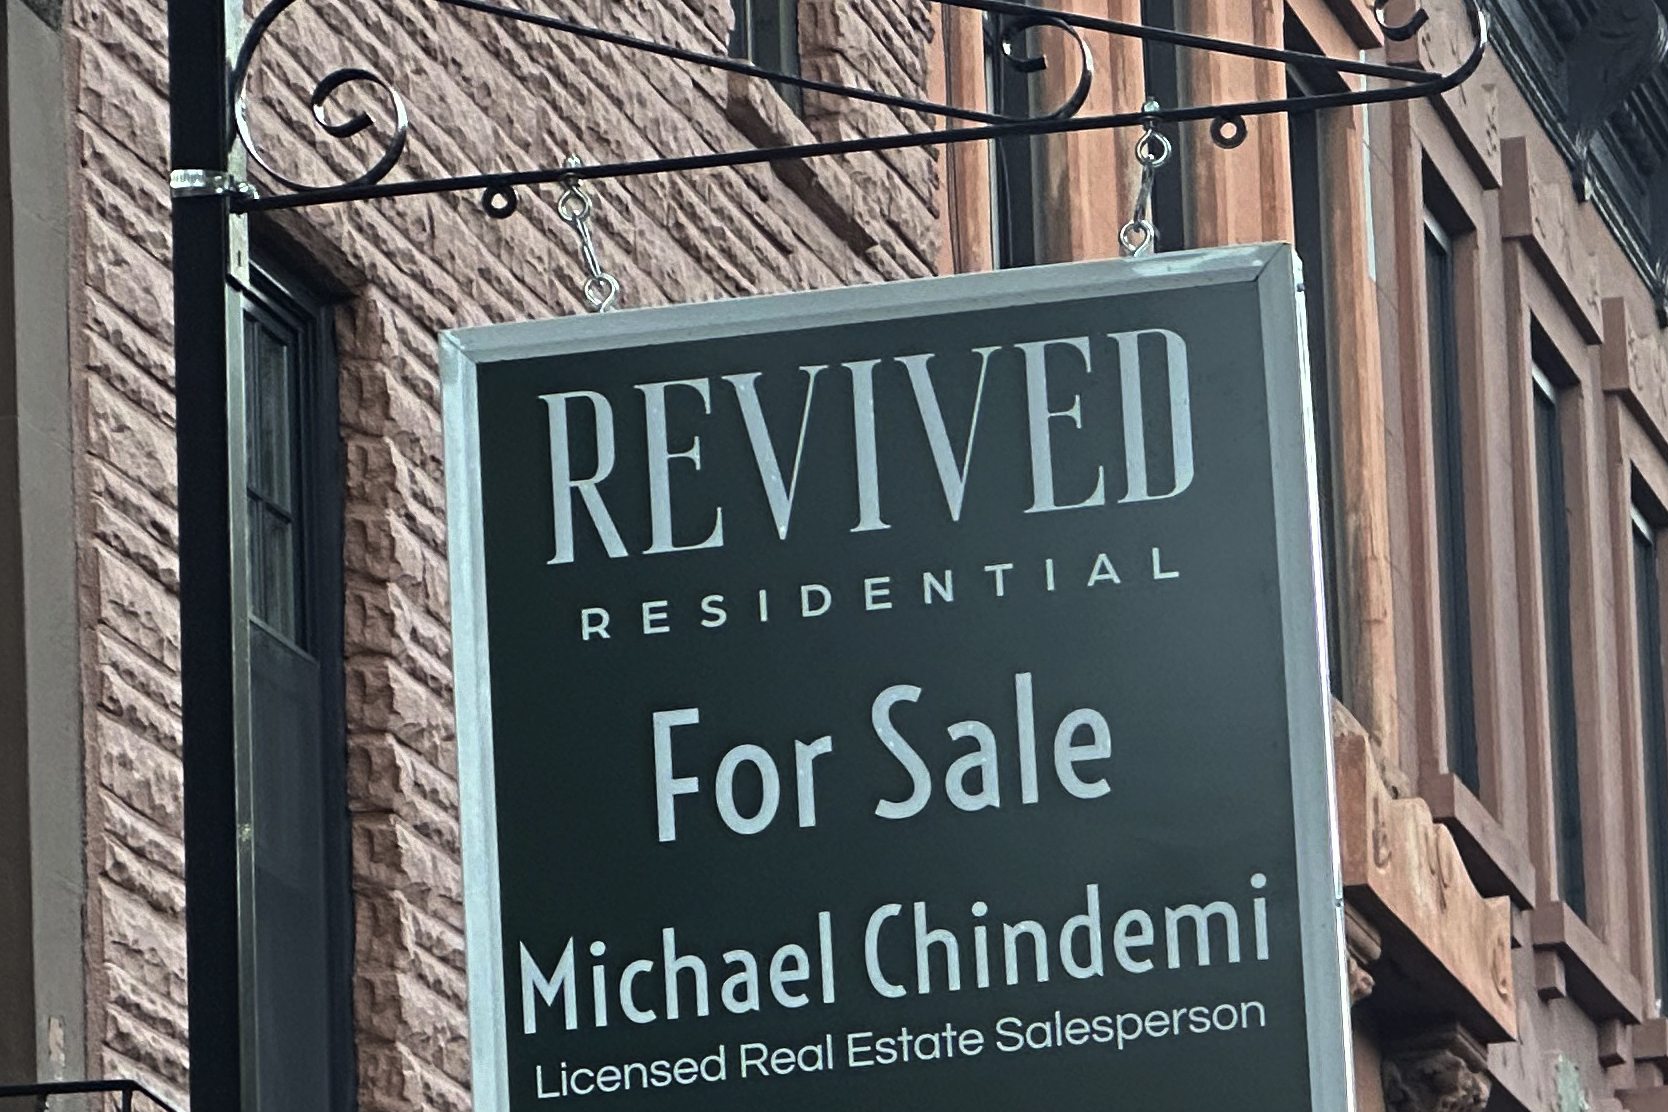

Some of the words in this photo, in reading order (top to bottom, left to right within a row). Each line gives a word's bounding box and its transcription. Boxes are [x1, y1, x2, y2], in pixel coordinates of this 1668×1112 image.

[538, 328, 1195, 564] REVIVED
[581, 548, 1180, 640] RESIDENTIAL
[653, 708, 832, 842] For
[872, 672, 1112, 819] Sale
[520, 911, 835, 1034] Michael
[865, 873, 1269, 998] Chindemi
[536, 1045, 726, 1098] Licensed
[740, 1034, 833, 1078] Real
[847, 1023, 984, 1067] Estate
[996, 1001, 1266, 1052] Salesperson
